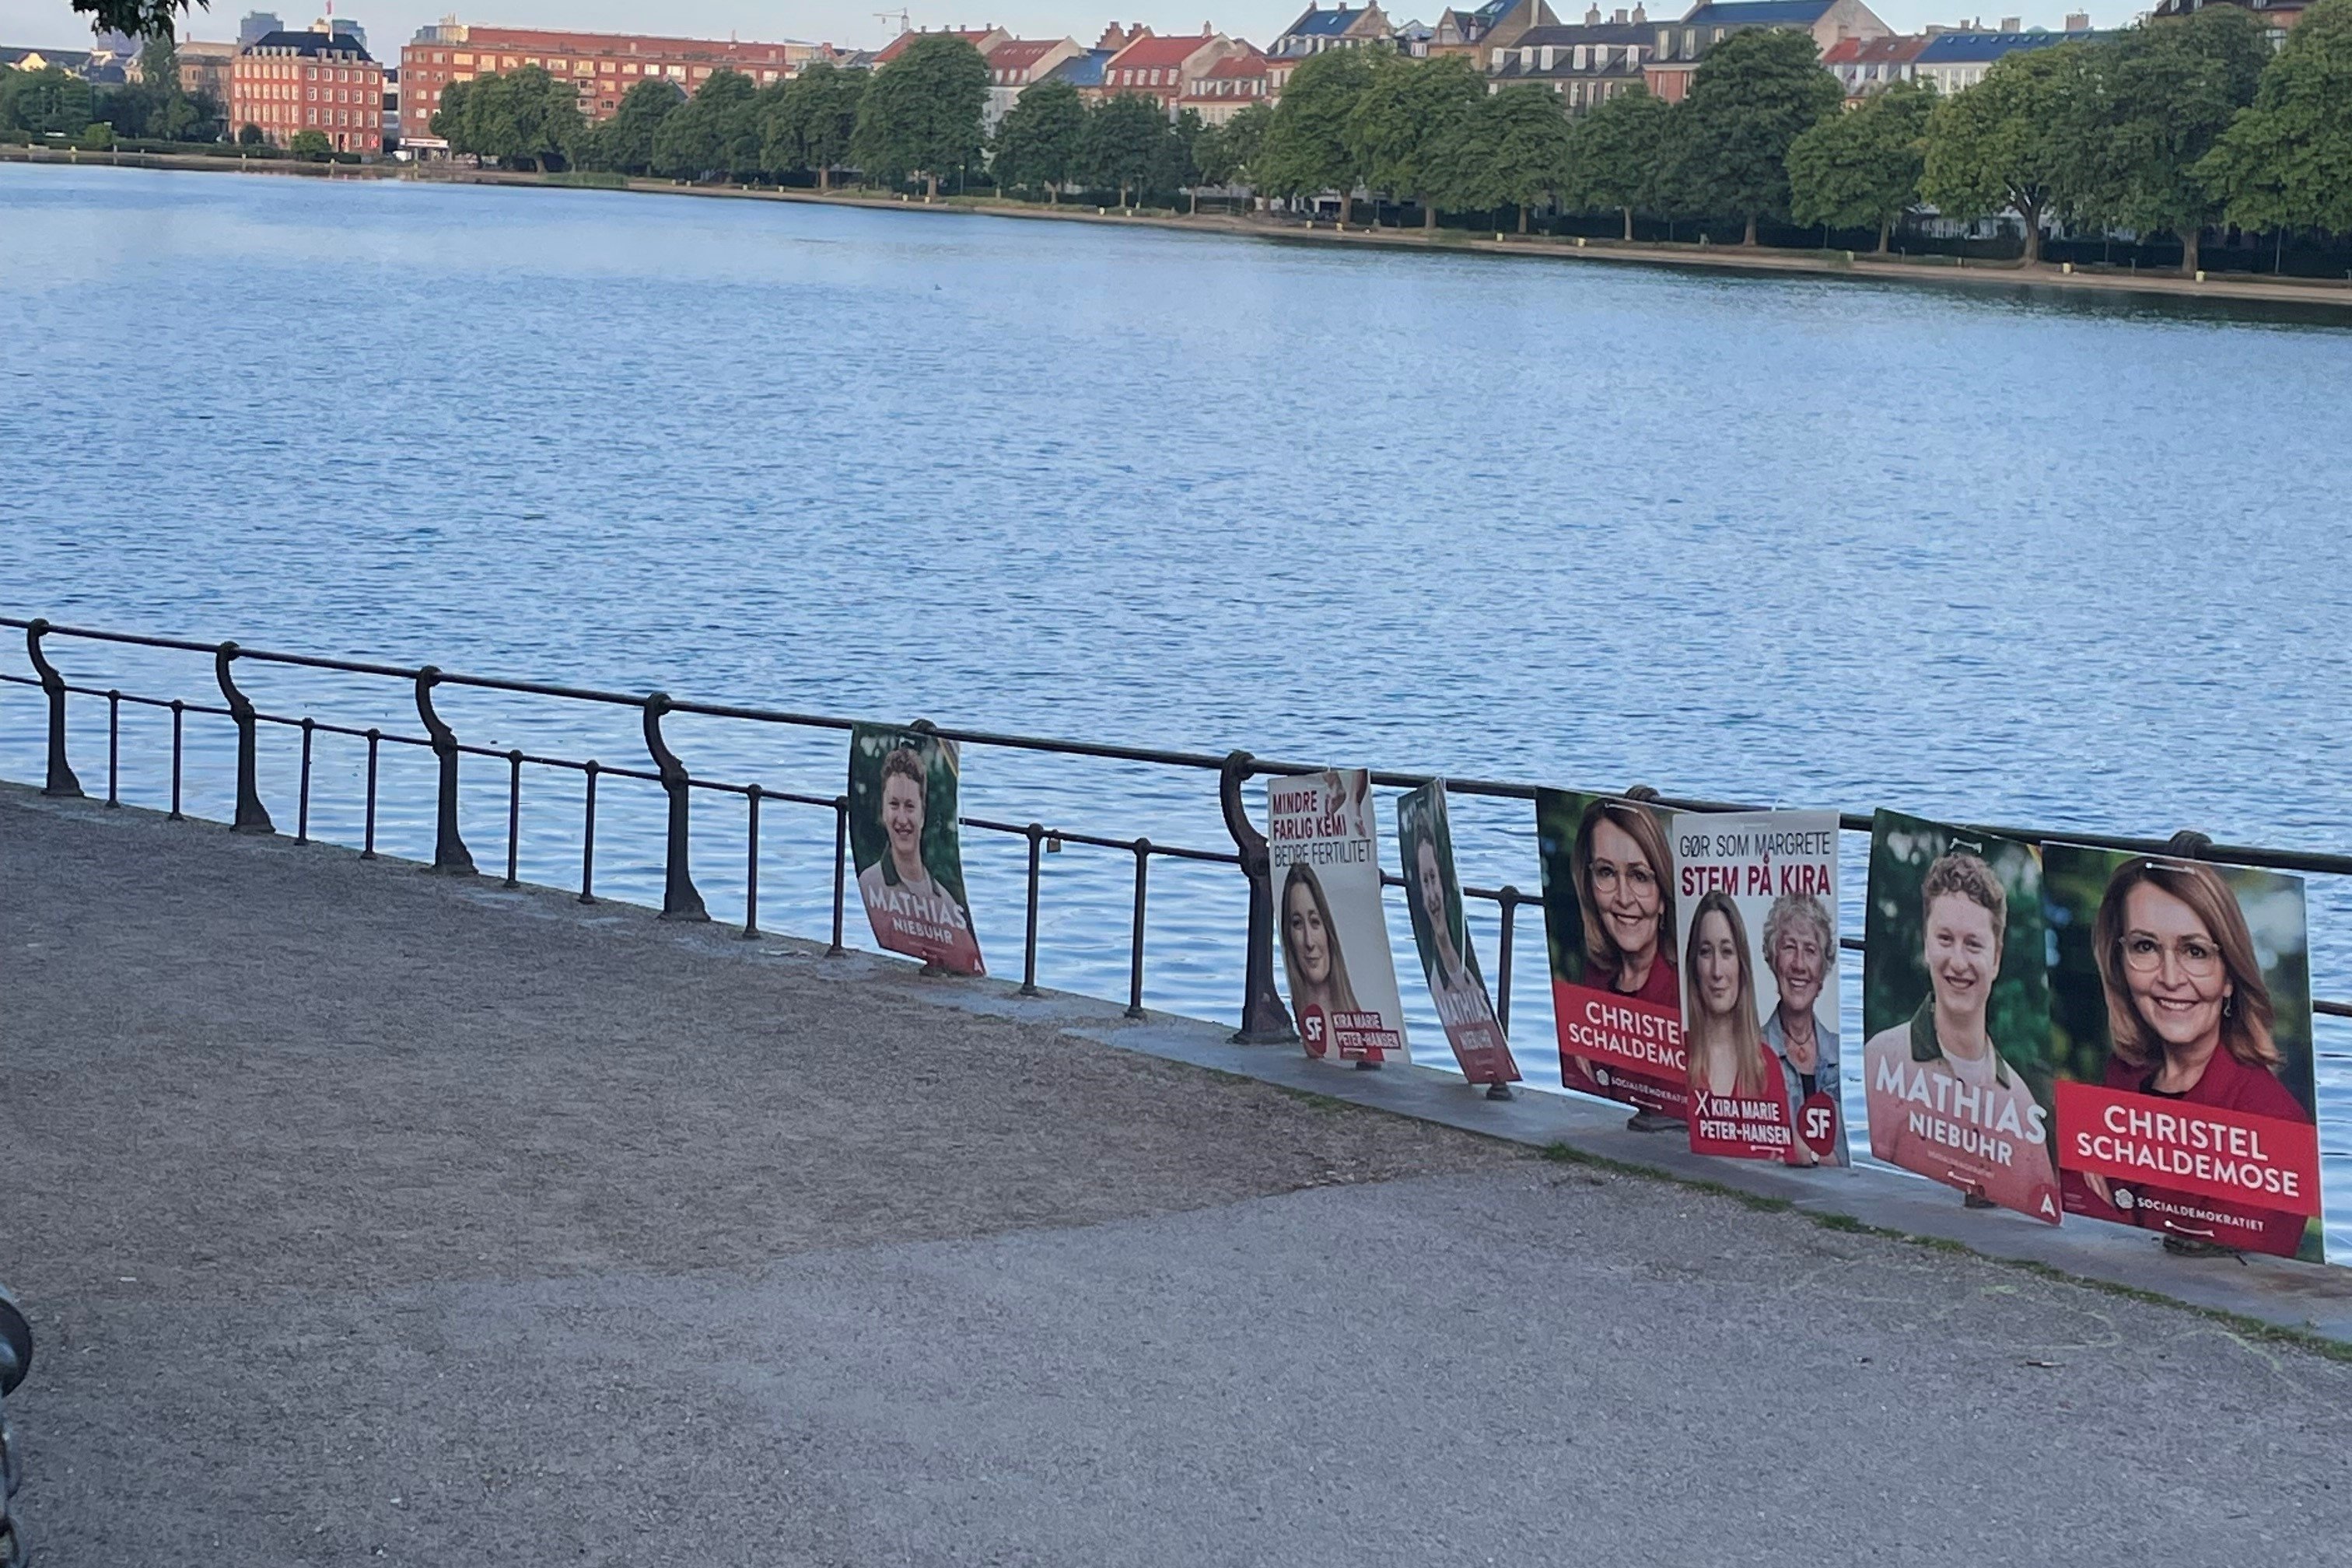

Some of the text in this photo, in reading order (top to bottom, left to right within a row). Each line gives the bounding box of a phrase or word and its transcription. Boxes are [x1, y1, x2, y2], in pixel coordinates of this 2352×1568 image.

[1272, 790, 1318, 815] MINDRE
[1273, 814, 1347, 841] FARLIG KEMI
[1274, 838, 1371, 867] BEDRE FERTILITET
[1679, 831, 1831, 858] GØR SOM MARGRETE
[1682, 853, 1832, 897] STEM PÅ KIRA
[868, 884, 967, 930] MATHIAS
[892, 916, 954, 946] NIEBUHR
[1305, 1016, 1322, 1041] SF
[1585, 1001, 1683, 1046] CHRISTE
[1568, 1023, 1687, 1071] SCHALDEMO
[1711, 1097, 1739, 1119] KIRA
[1741, 1099, 1780, 1122] MARIE
[1875, 1054, 2049, 1145] MATHIAS
[1699, 1119, 1791, 1146] PETER-HANSEN
[1805, 1107, 1831, 1139] SF
[1909, 1110, 2013, 1167] NIEBUHR
[2103, 1104, 2269, 1162] CHRISTEL
[2076, 1132, 2301, 1199] SCHALDEMOSE
[2040, 1192, 2056, 1218] A
[2137, 1195, 2265, 1233] SOCIALDEMOKRATIET
